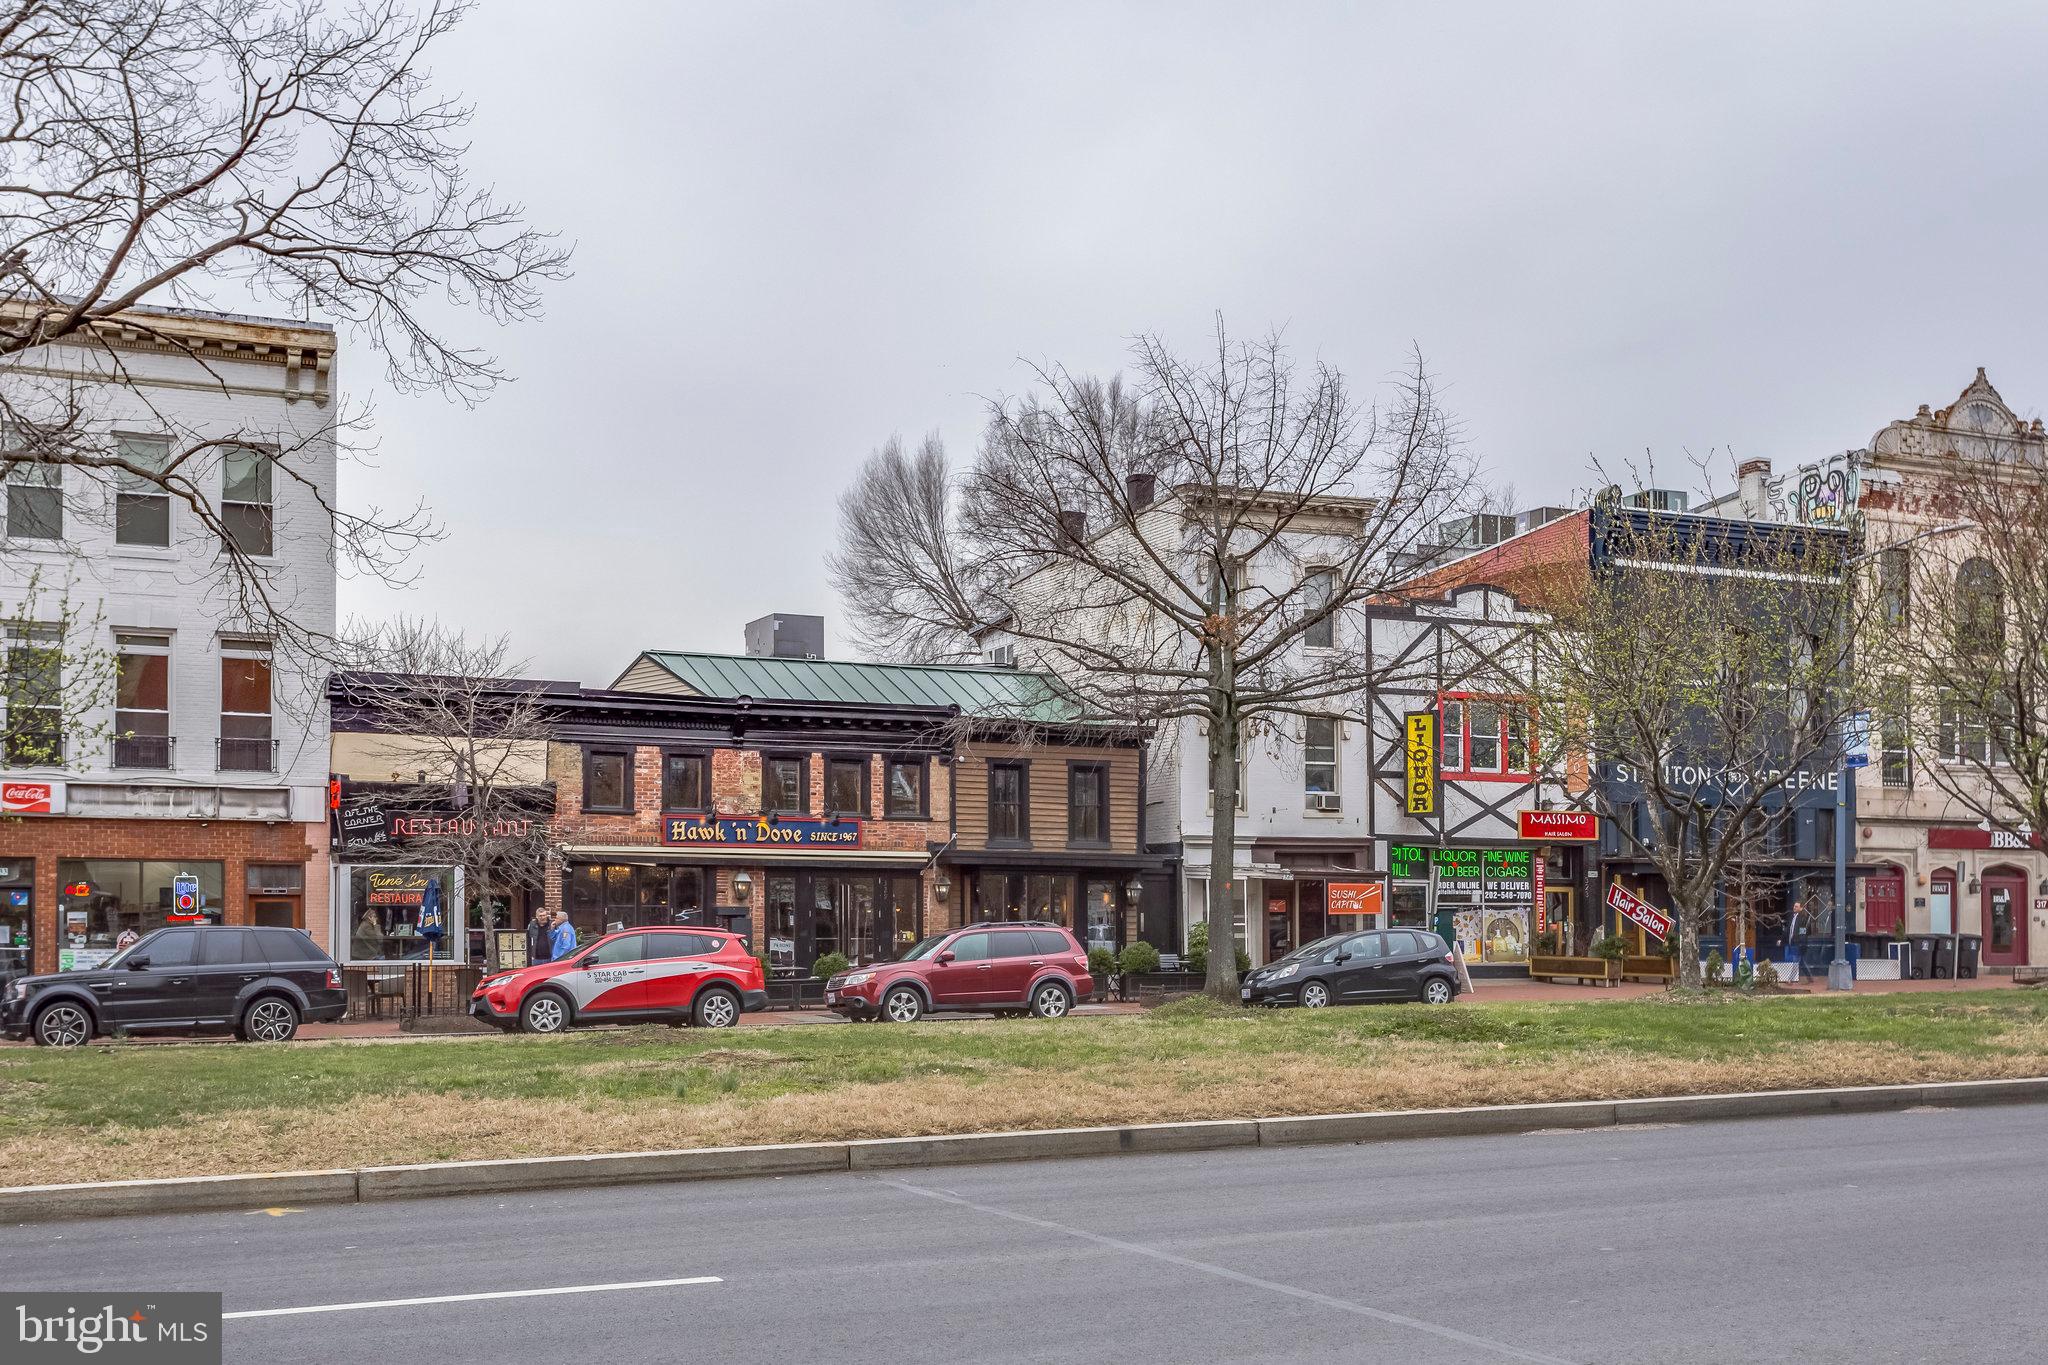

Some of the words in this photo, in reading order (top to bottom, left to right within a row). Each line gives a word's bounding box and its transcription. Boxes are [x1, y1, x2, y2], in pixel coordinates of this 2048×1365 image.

[1413, 718, 1428, 811] LIQUOR
[1616, 764, 1711, 786] STTON
[1530, 813, 1586, 824] MASSIMO
[671, 821, 726, 841] Hawk
[755, 821, 802, 842] Dove
[810, 832, 838, 842] SINCE
[839, 832, 857, 842] 1967
[1993, 831, 2033, 848] BB&T
[1392, 847, 1425, 861] PITOL
[1432, 850, 1477, 862] LIQUOR
[1484, 850, 1502, 862] FINE
[1504, 851, 1530, 863] WINE
[1392, 863, 1411, 877] ILL
[1439, 866, 1455, 877] OLD
[1457, 866, 1480, 877] BEER
[1485, 866, 1528, 878] CIGARS
[369, 873, 404, 888] Tune
[1438, 881, 1455, 890] RDER
[1457, 881, 1480, 890] ONLINE
[1486, 881, 1498, 890] WE
[1500, 881, 1530, 891] DELIVER
[370, 893, 423, 904] RESTAURA
[1331, 890, 1356, 899] SUSHI
[1613, 889, 1635, 912] Hair
[1632, 905, 1665, 935] Salon
